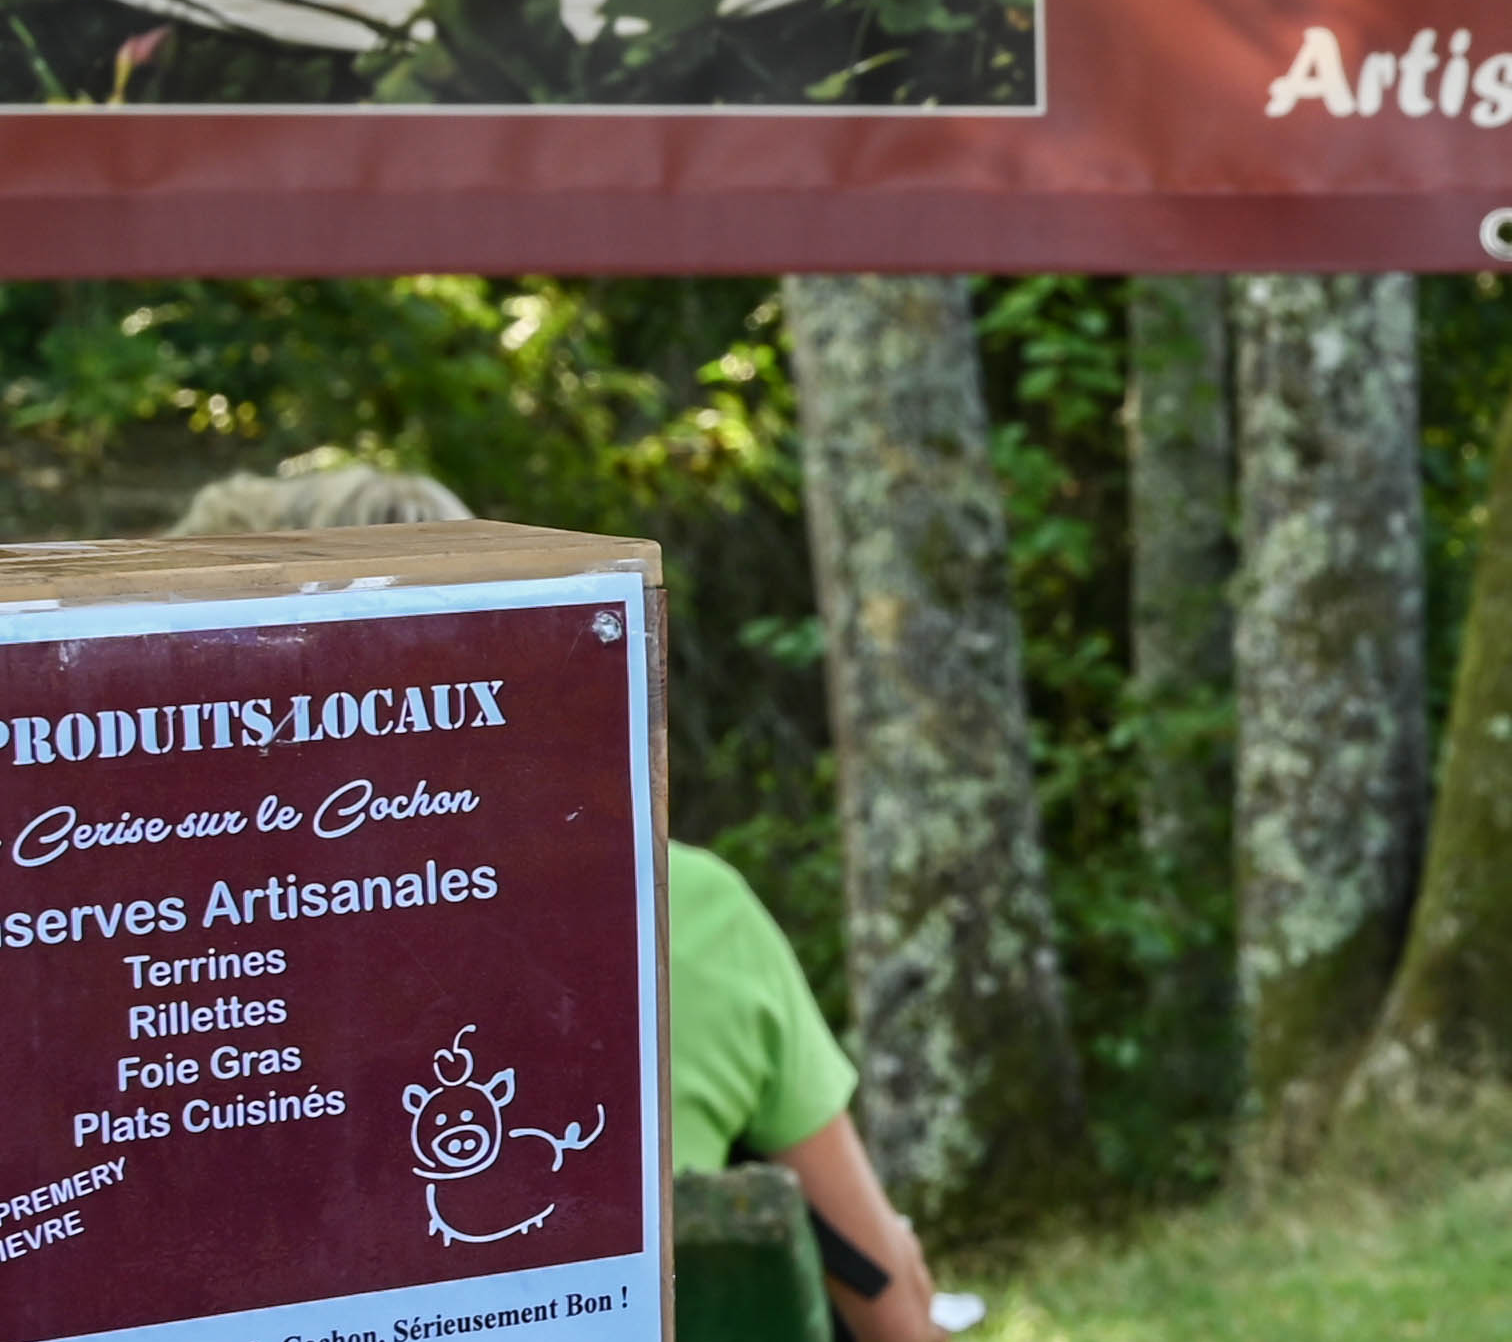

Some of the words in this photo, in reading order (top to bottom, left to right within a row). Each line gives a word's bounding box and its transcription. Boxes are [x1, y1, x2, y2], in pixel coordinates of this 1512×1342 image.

[290, 680, 506, 743] LOCAUX
[12, 805, 171, 867] Cerise
[176, 804, 248, 839] sur
[256, 795, 303, 831] le
[313, 779, 479, 839] Cochon
[0, 895, 187, 948] serves
[202, 859, 498, 929] Artisanales
[124, 946, 288, 989] Terrines
[128, 996, 288, 1040] Rillettes
[117, 1051, 199, 1092] Foie
[211, 1043, 301, 1079] Gras
[74, 1104, 171, 1148] Plats
[182, 1085, 345, 1133] Cuisinés
[566, 1291, 613, 1318] Bon
